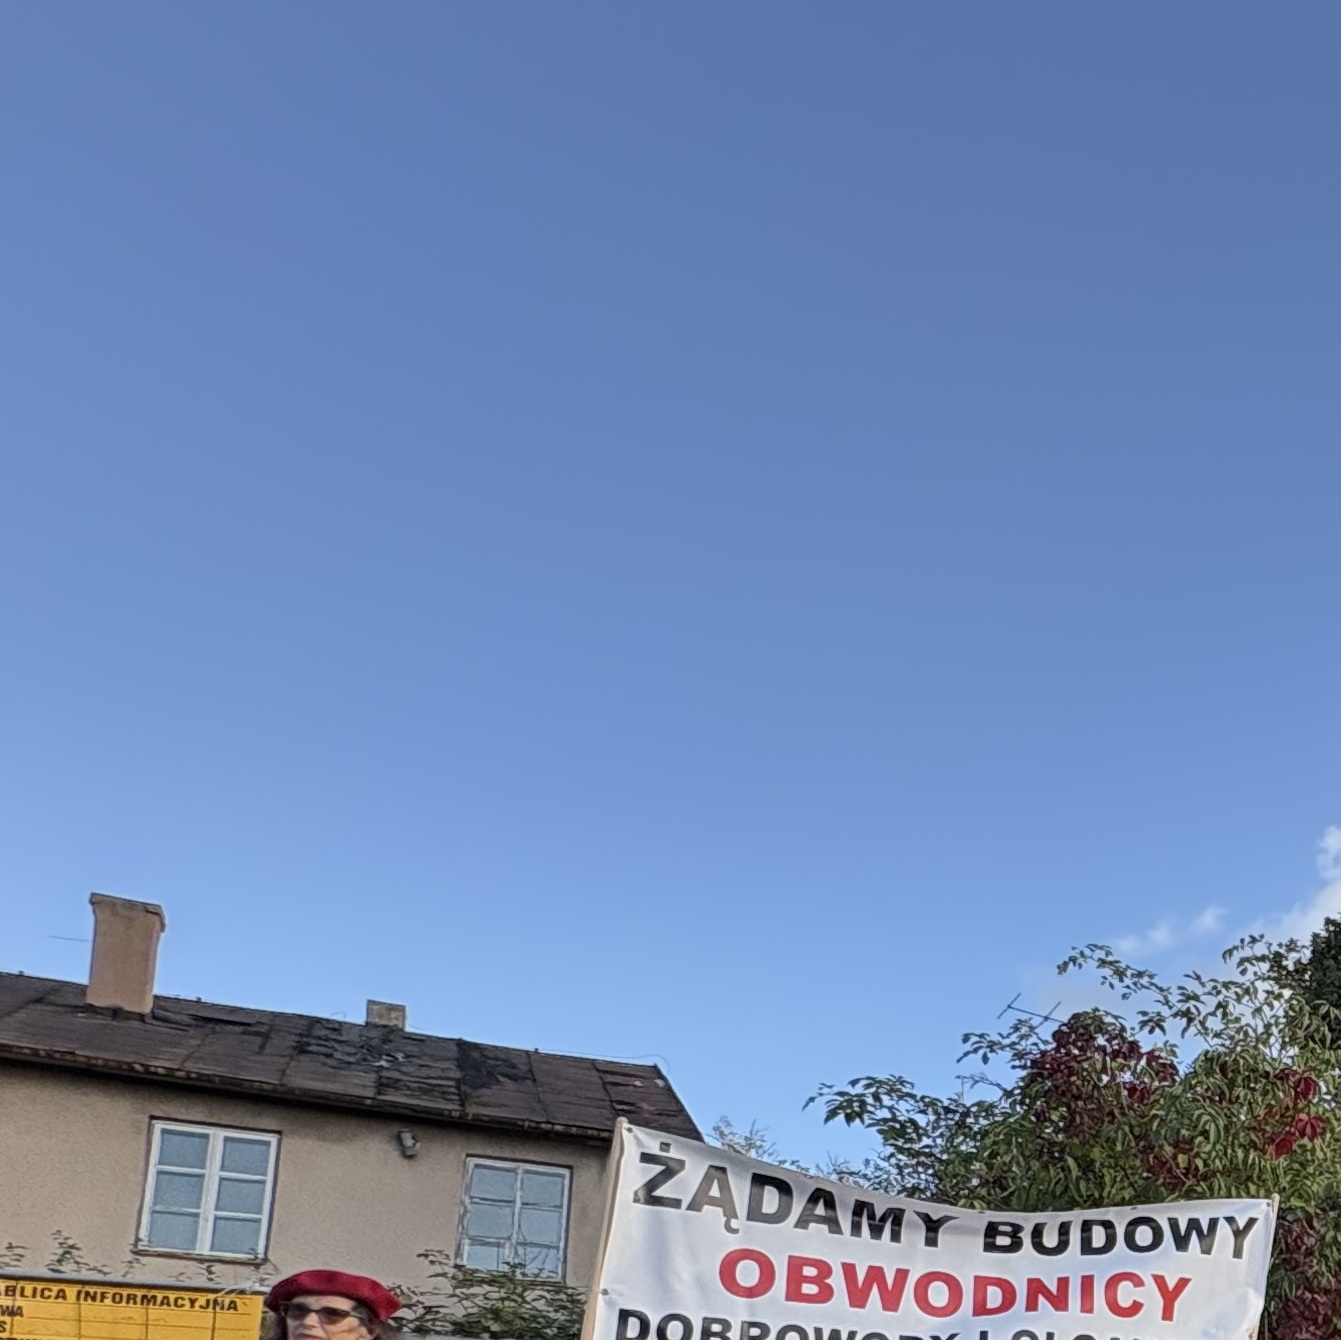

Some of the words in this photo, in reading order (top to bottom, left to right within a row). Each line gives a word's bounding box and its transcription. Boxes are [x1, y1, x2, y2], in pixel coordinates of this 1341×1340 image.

[633, 1141, 958, 1247] ŻĄDAMY
[983, 1214, 1258, 1260] BUDOWY
[0, 1285, 67, 1300] BLICA
[76, 1289, 239, 1312] INFORMACYJNA
[719, 1247, 1192, 1322] OBWODNICY
